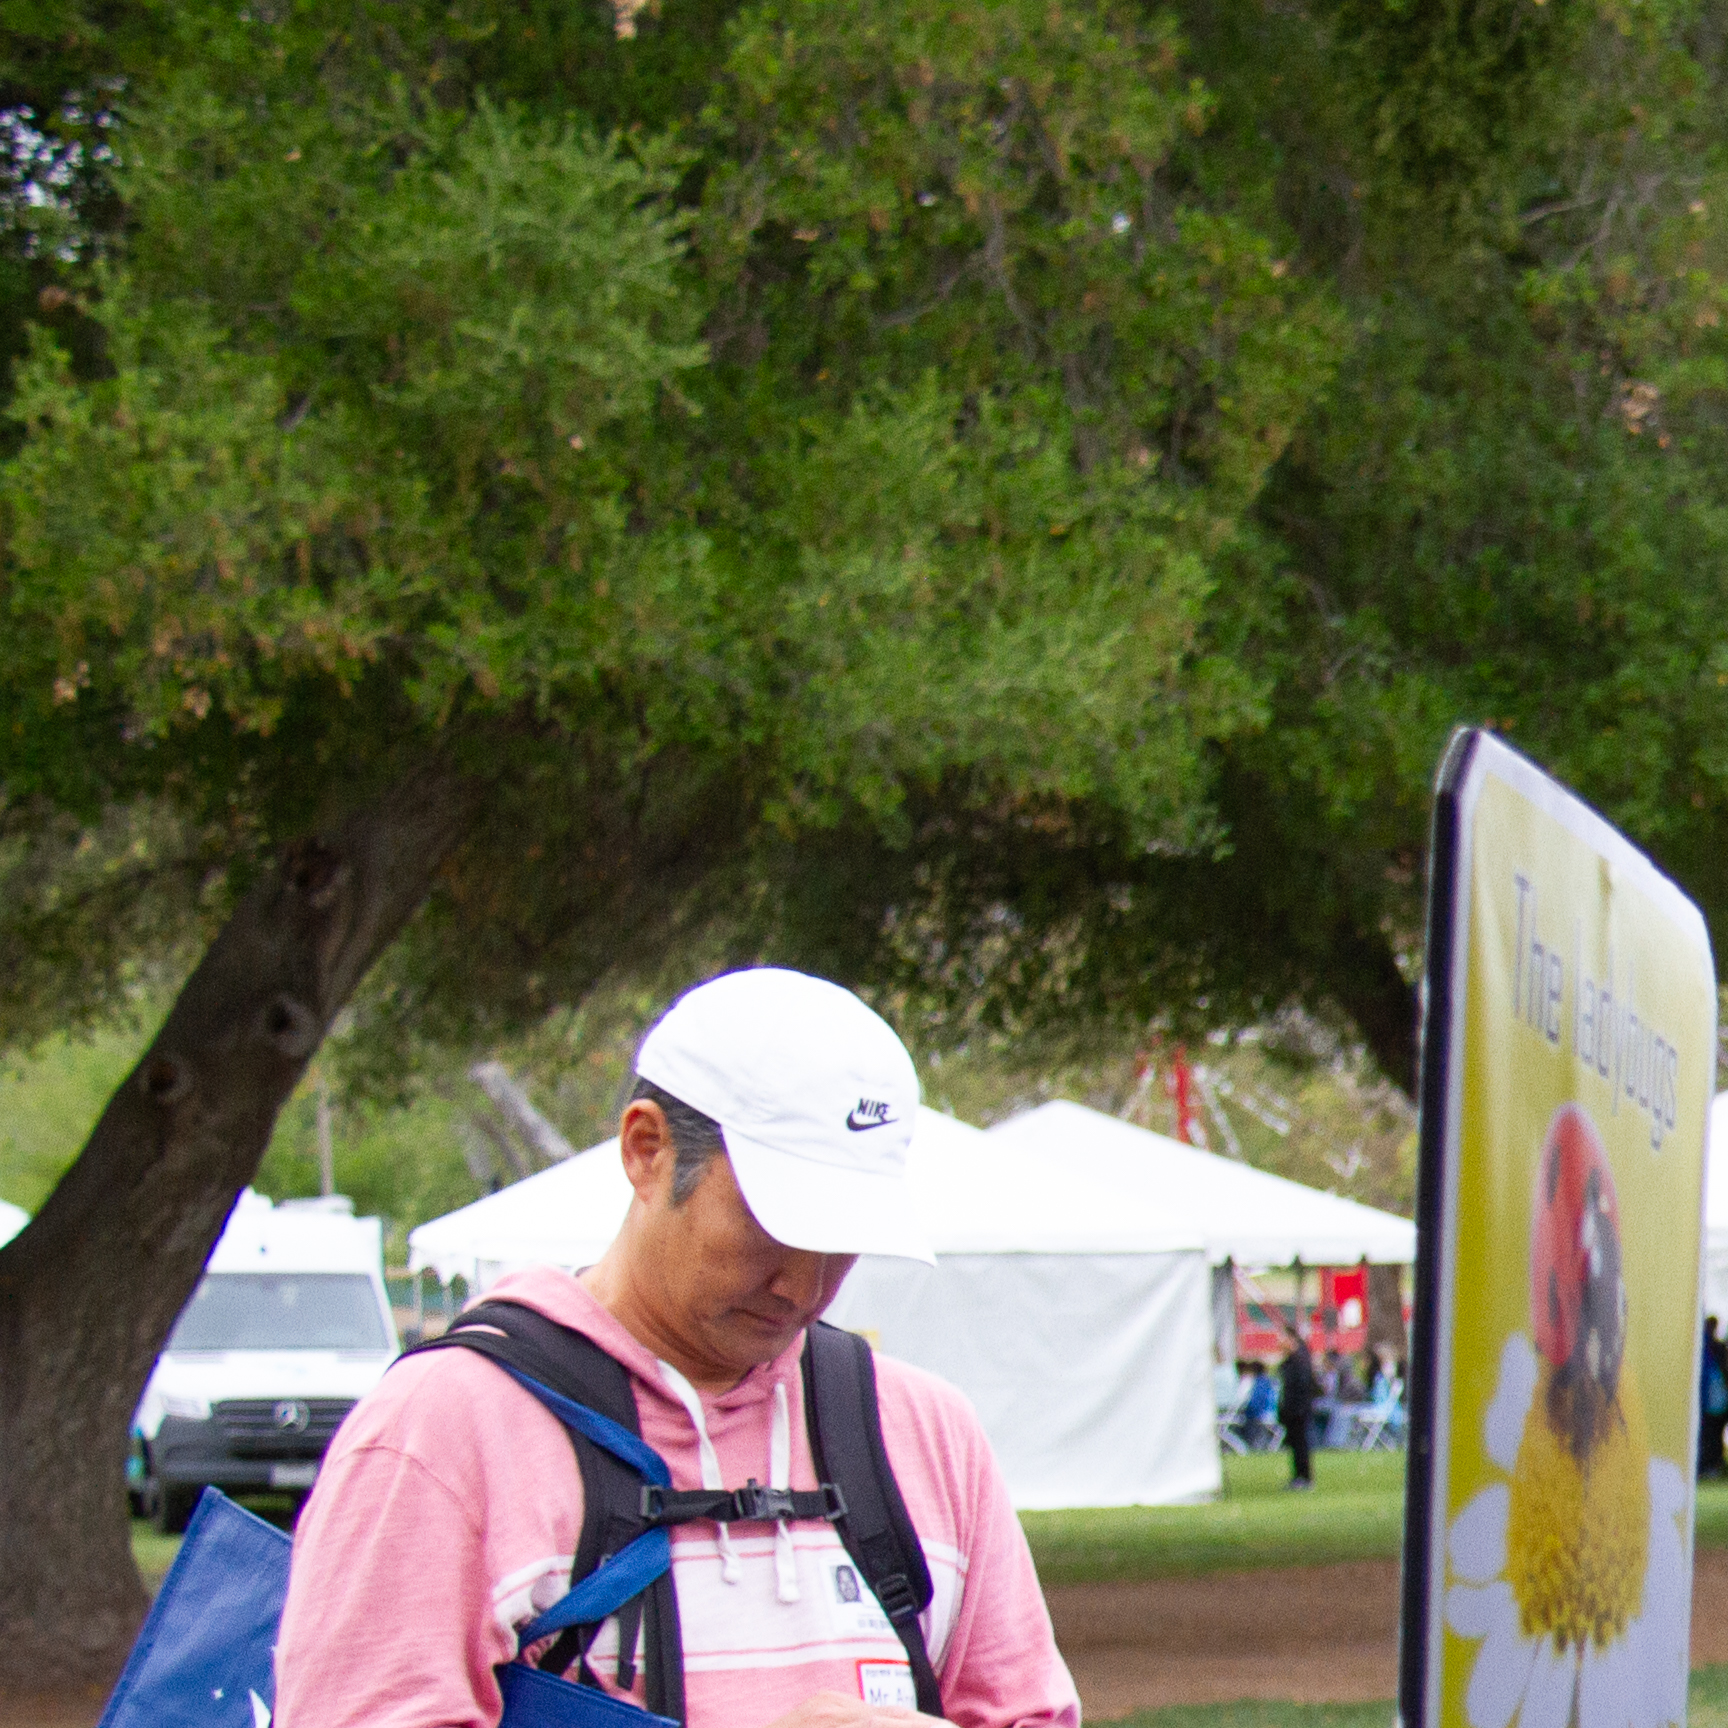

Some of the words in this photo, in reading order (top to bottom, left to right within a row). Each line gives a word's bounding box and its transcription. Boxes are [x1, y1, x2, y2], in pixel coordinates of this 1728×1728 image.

[1515, 872, 1563, 1044] The
[1572, 916, 1678, 1150] ladybugs
[857, 1098, 889, 1121] NIKE
